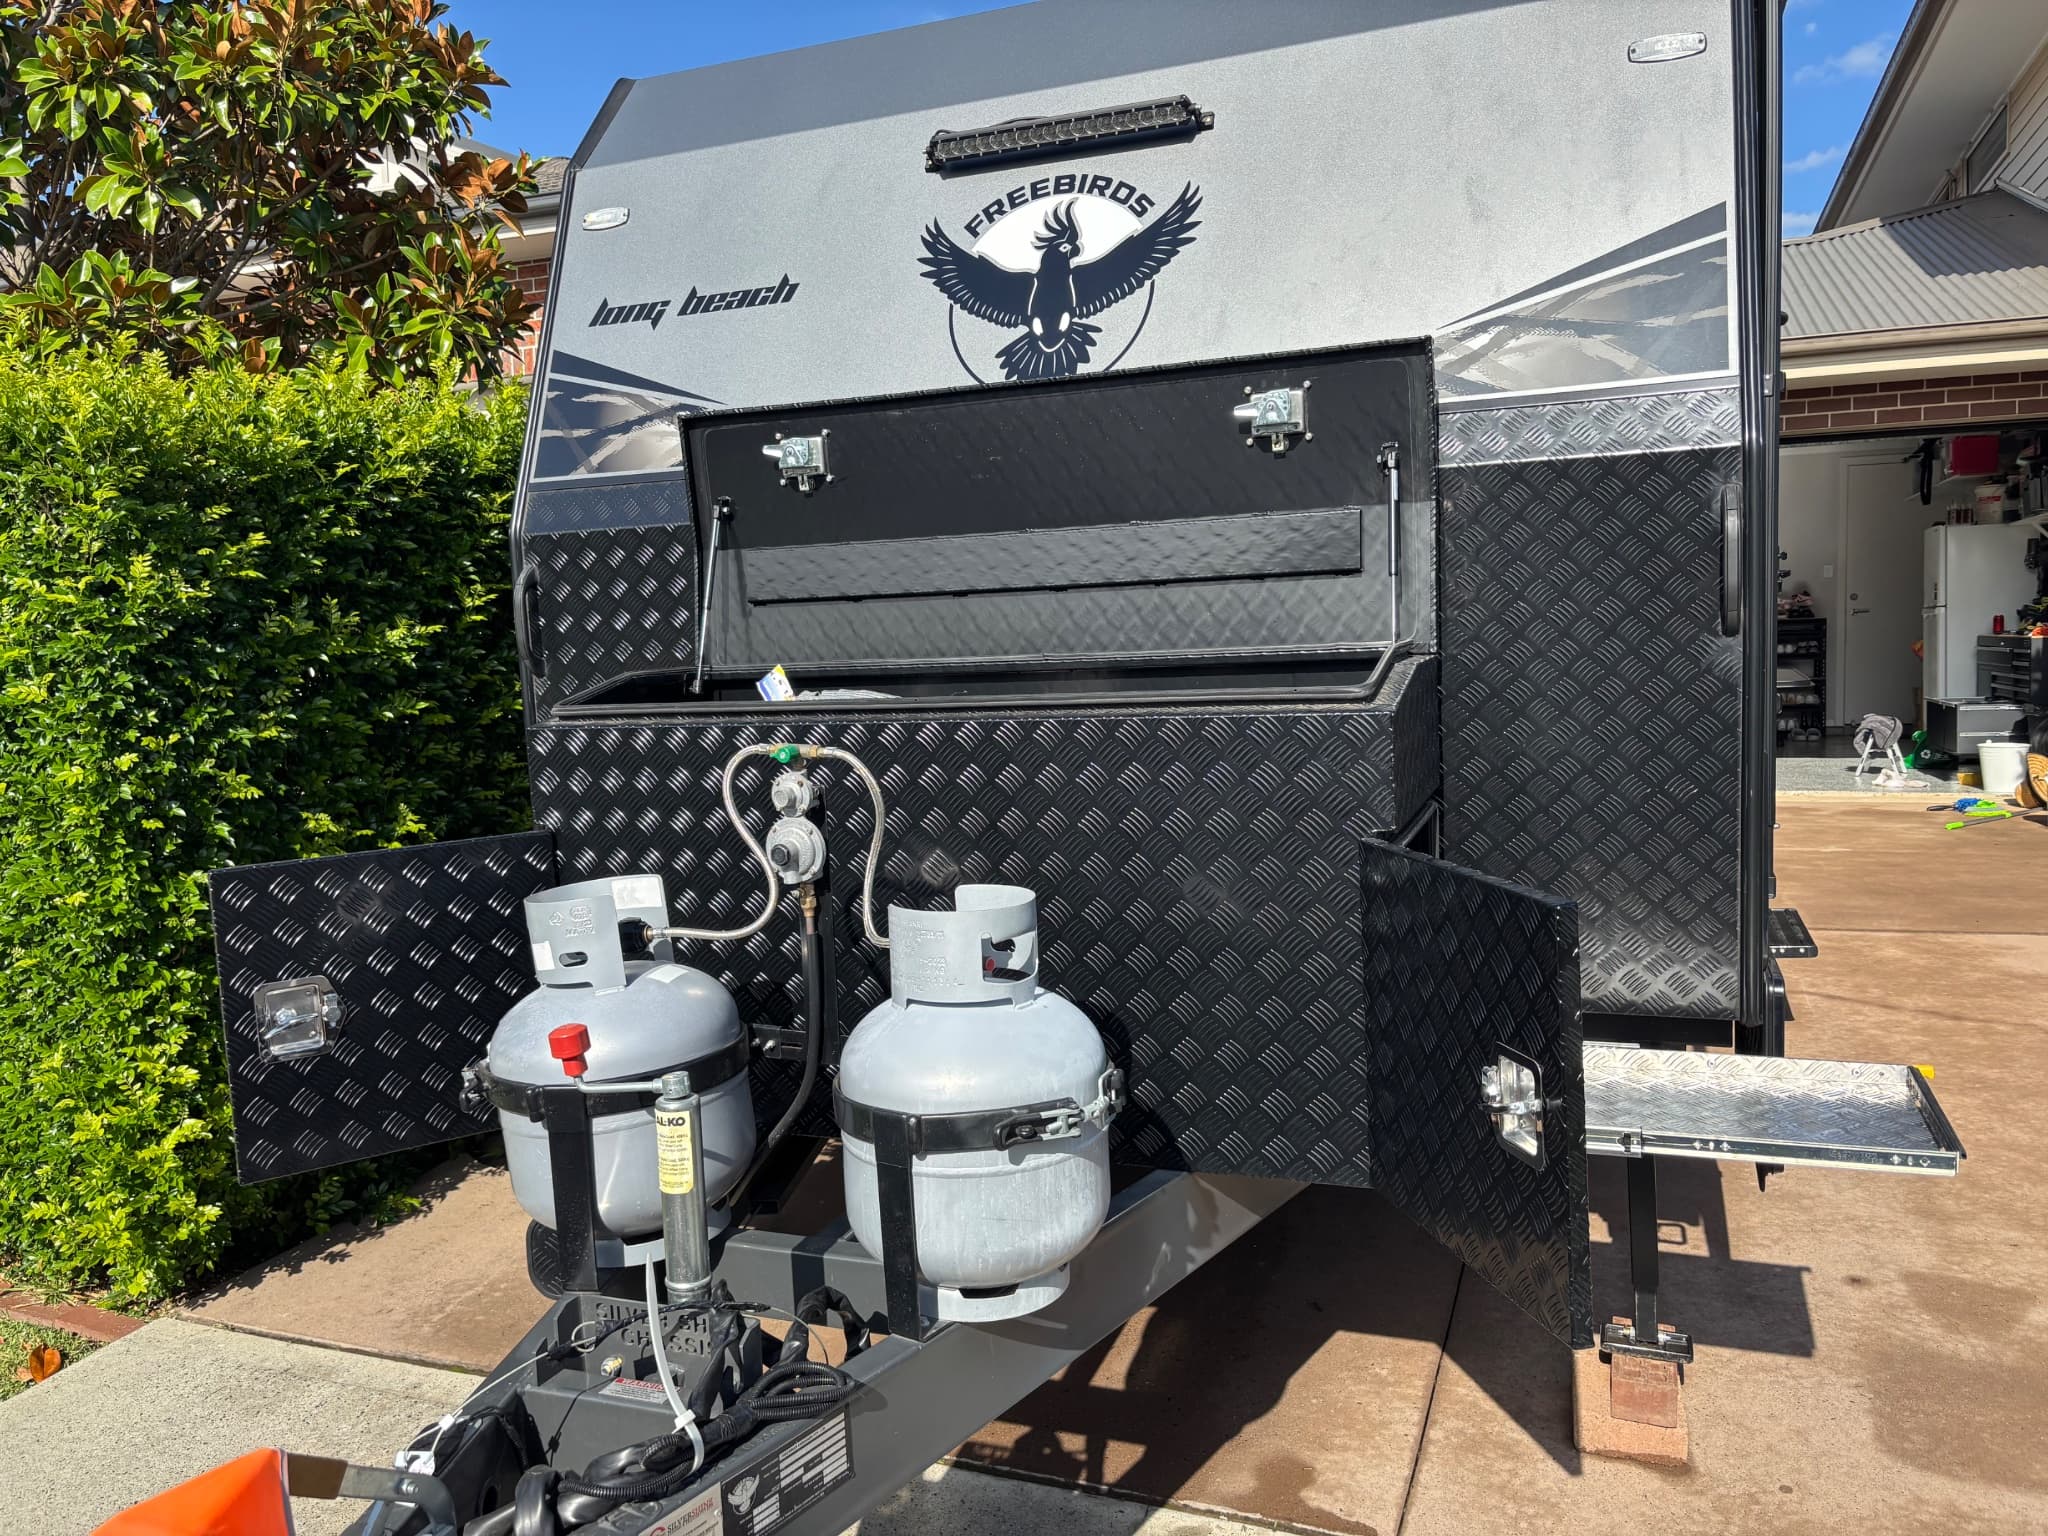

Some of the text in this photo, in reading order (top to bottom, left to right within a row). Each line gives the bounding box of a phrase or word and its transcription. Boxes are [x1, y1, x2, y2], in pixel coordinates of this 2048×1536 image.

[964, 173, 1155, 239] FREEBIRDS
[588, 272, 801, 331] long beach
[621, 1328, 712, 1357] CHSSI
[624, 1378, 667, 1391] WARNIN
